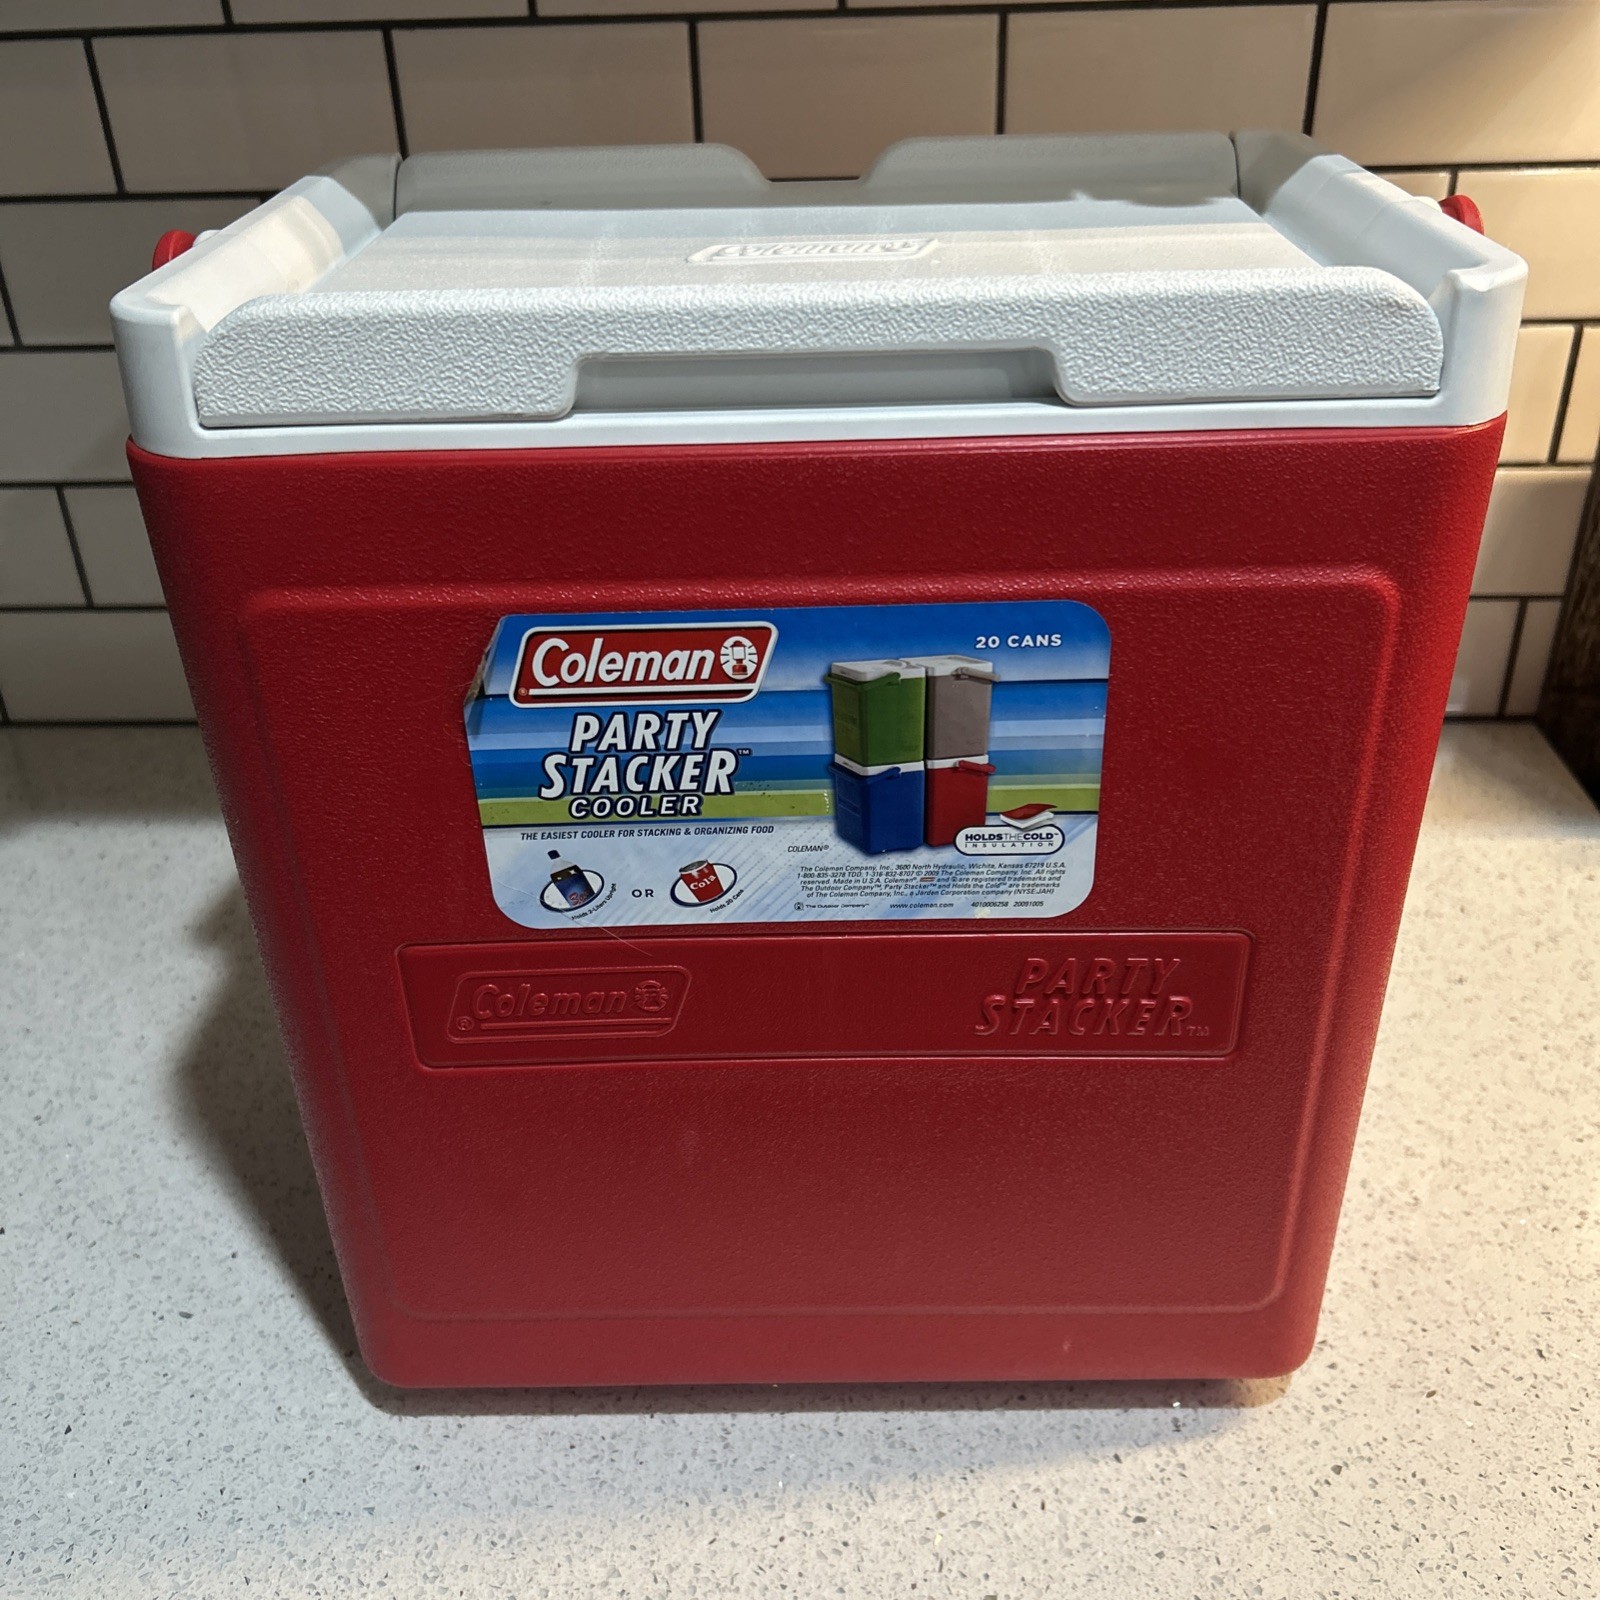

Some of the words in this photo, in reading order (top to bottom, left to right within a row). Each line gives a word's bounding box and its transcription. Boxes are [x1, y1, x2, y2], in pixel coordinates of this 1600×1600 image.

[975, 635, 1000, 649] 20
[1007, 633, 1062, 648] CANS
[532, 637, 716, 687] Coleman
[570, 711, 720, 752] PARTY
[569, 796, 701, 817] COOLER
[520, 832, 538, 841] THE
[540, 831, 579, 840] EASIEST
[580, 829, 616, 839] COOLER
[617, 829, 635, 838] FOR
[636, 827, 682, 837] STACKING
[683, 827, 691, 836] &
[693, 826, 749, 836] ORGANIZING
[750, 825, 775, 834] FOOD
[845, 865, 877, 873] Company,
[932, 863, 966, 871] Hydraulic,
[968, 862, 996, 870] Wichita,
[1046, 868, 1066, 876] rights
[689, 875, 717, 890] Cola
[631, 888, 655, 899] OR
[709, 903, 726, 914] Holds
[732, 888, 745, 901] Cans
[859, 890, 892, 898] Company,
[889, 902, 955, 910] www.coleman.com
[1013, 900, 1044, 908] 20091005
[1014, 957, 1182, 996] PARTY
[471, 983, 628, 1021] Coleman
